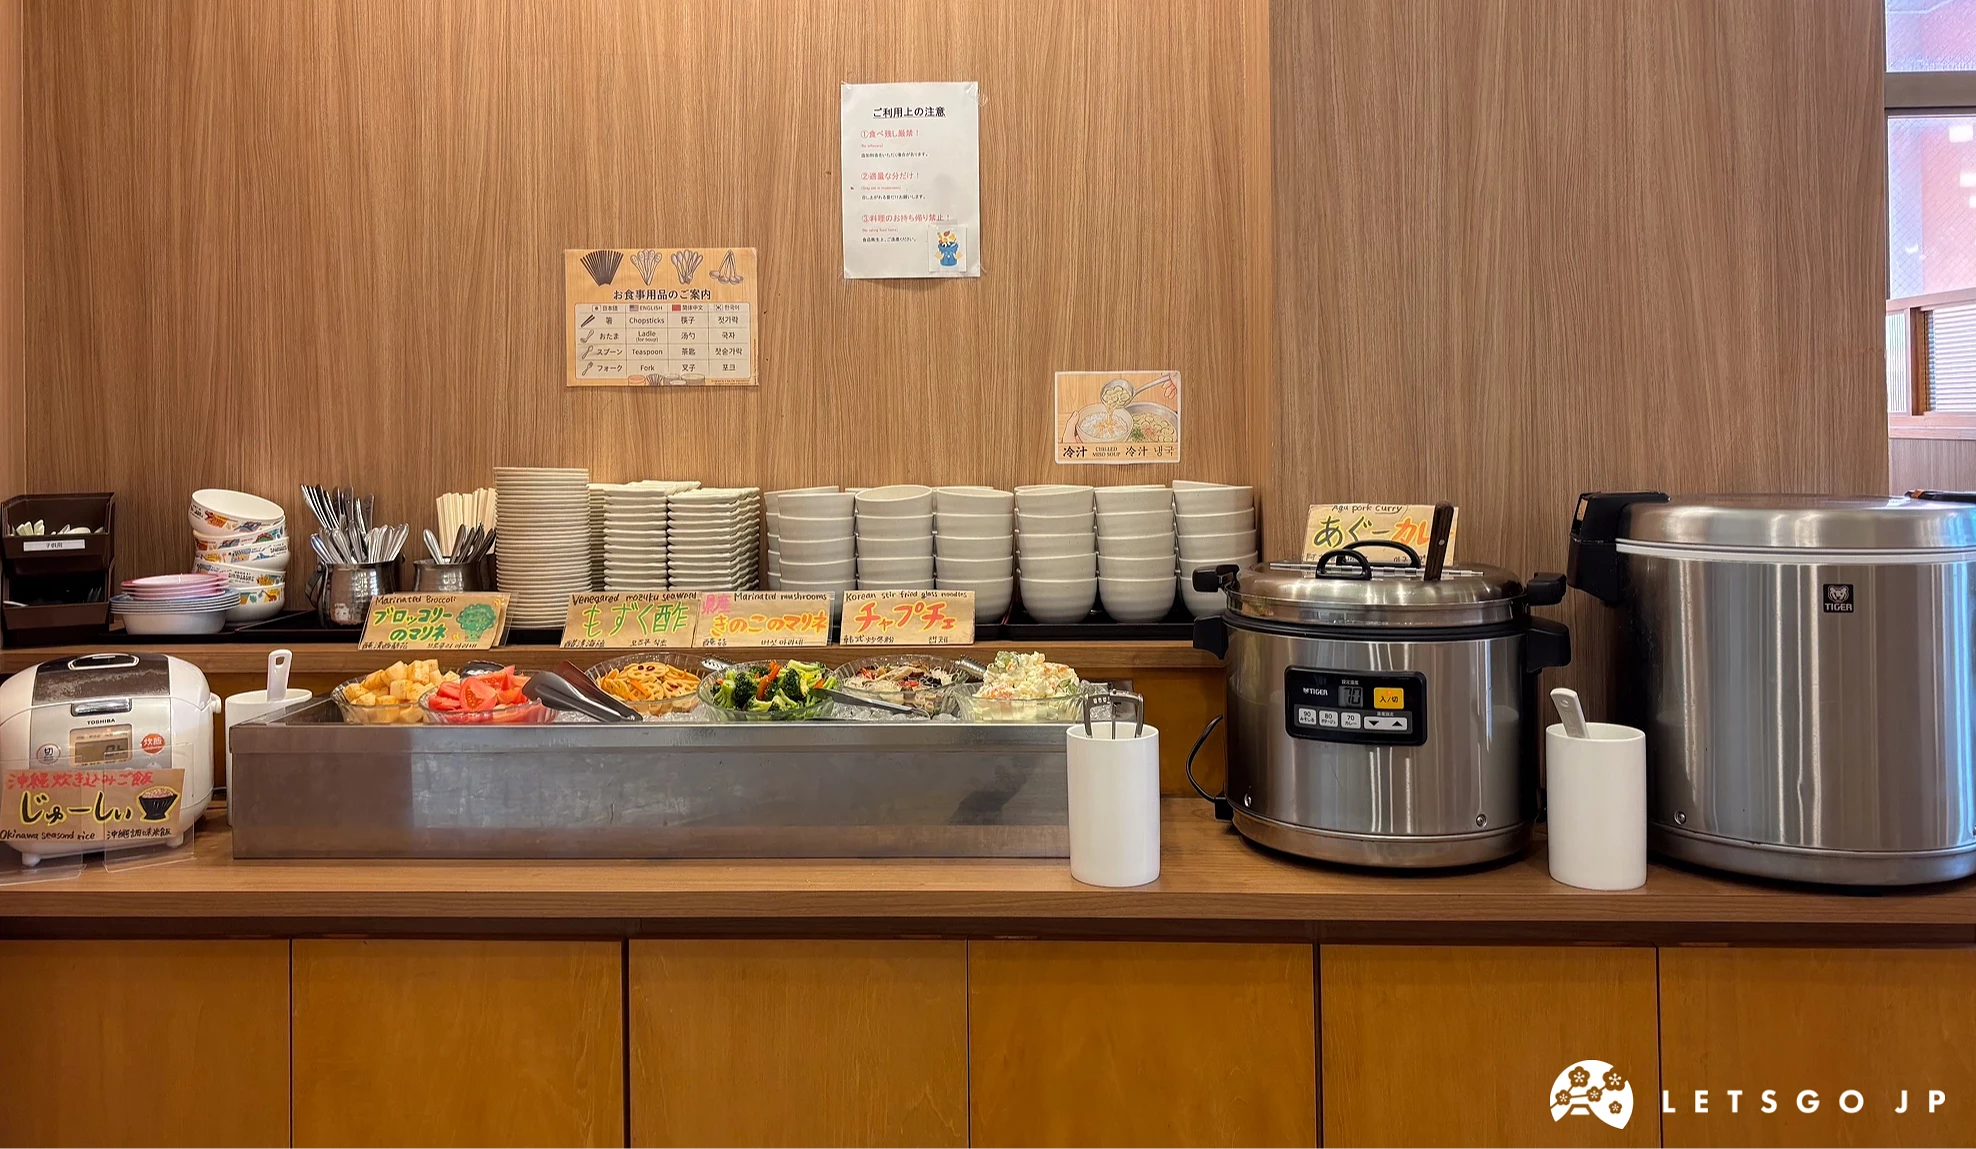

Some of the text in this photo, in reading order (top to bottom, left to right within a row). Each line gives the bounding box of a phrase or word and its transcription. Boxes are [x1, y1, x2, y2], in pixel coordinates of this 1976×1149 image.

[873, 107, 946, 118] ご利用上の注意
[613, 289, 711, 301] お食事用品のご案内
[600, 332, 619, 340] おたま
[597, 348, 623, 356] スプーン
[597, 364, 623, 372] フォーク
[1063, 446, 1088, 458] 冷汁
[1125, 446, 1148, 457] 冷汁
[1332, 504, 1403, 513] Agu pork curry
[1314, 515, 1454, 548] あぐーカレ
[426, 595, 457, 604] Broccoli
[572, 594, 619, 606] Venegared
[626, 593, 659, 602] mozuku
[780, 592, 827, 601] mushrooms
[845, 592, 877, 602] Korean
[881, 591, 896, 599] stir
[900, 590, 918, 598] fried
[921, 590, 938, 600] glass
[1824, 603, 1853, 611] TIGER
[374, 606, 453, 626] ブロッコリー
[583, 601, 689, 637] もずく酢
[855, 602, 956, 634] チャプチェ
[711, 611, 828, 637] きのこのマリネ
[389, 624, 447, 641] のマリネ
[1310, 688, 1328, 696] TIGER
[44, 747, 54, 756] 切
[8, 771, 154, 790] 沖縄炊き込みご飯
[1, 829, 39, 841] Okinawa
[77, 831, 95, 840] rice
